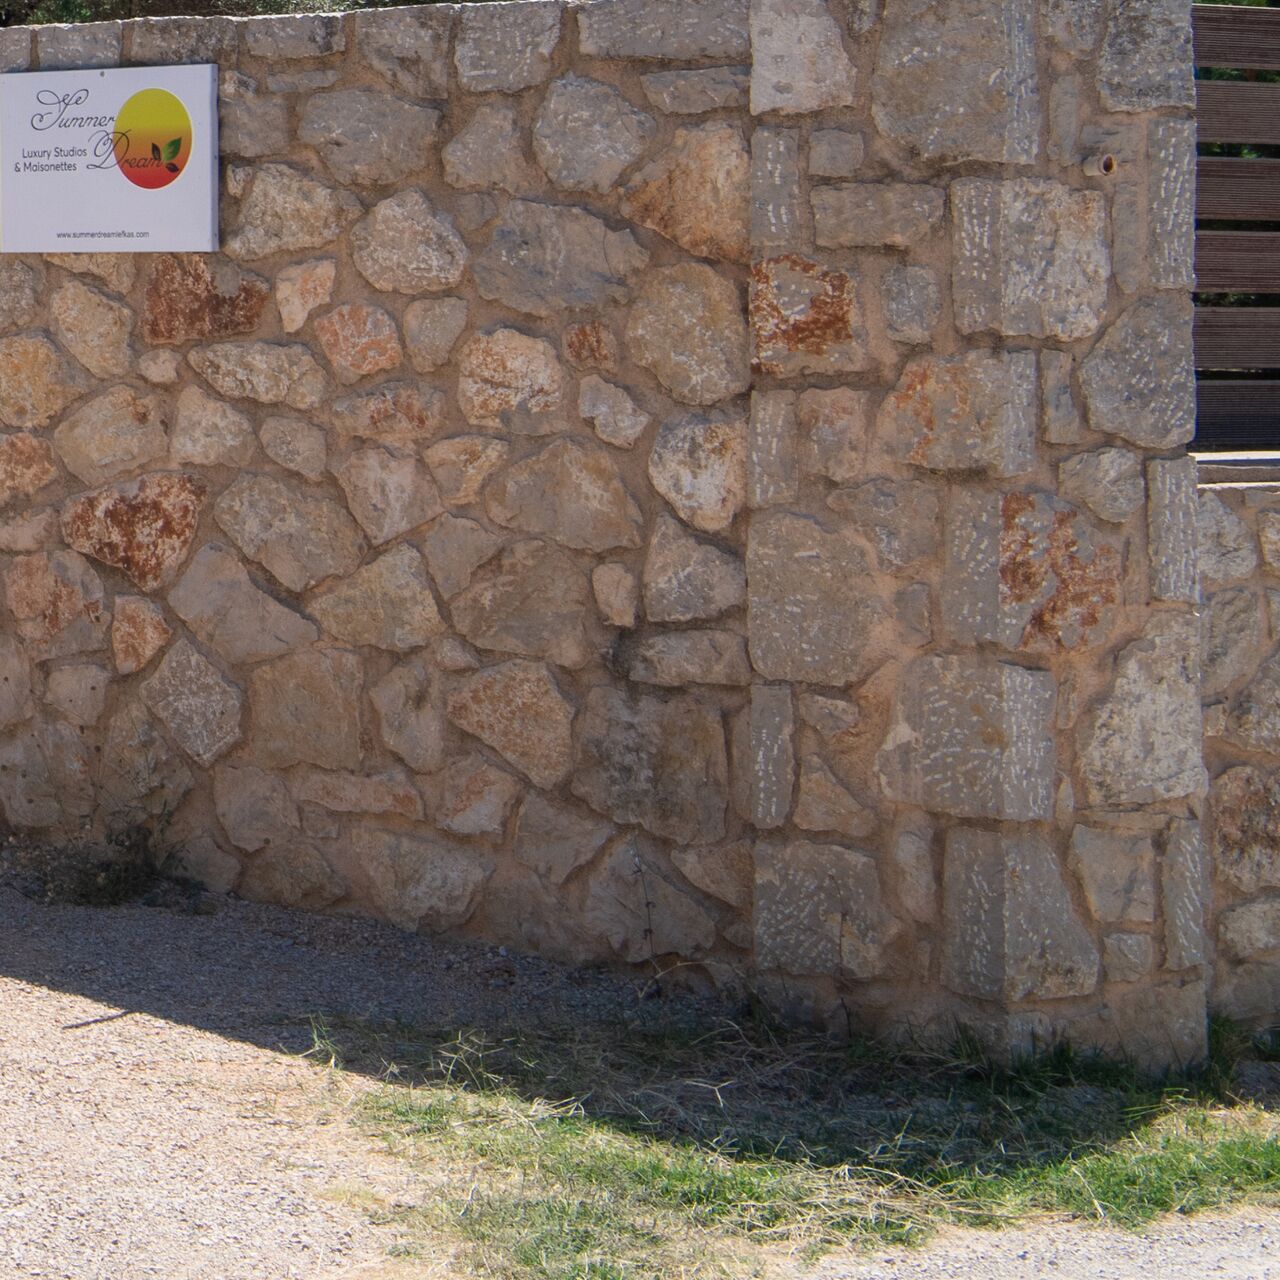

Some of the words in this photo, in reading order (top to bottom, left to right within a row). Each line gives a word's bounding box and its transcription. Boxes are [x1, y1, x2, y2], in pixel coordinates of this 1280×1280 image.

[31, 88, 116, 131] Summer
[22, 148, 52, 159] Luxury
[54, 146, 87, 158] Studios
[86, 130, 162, 169] Dream
[14, 163, 21, 172] &
[23, 161, 77, 172] Maisonettes
